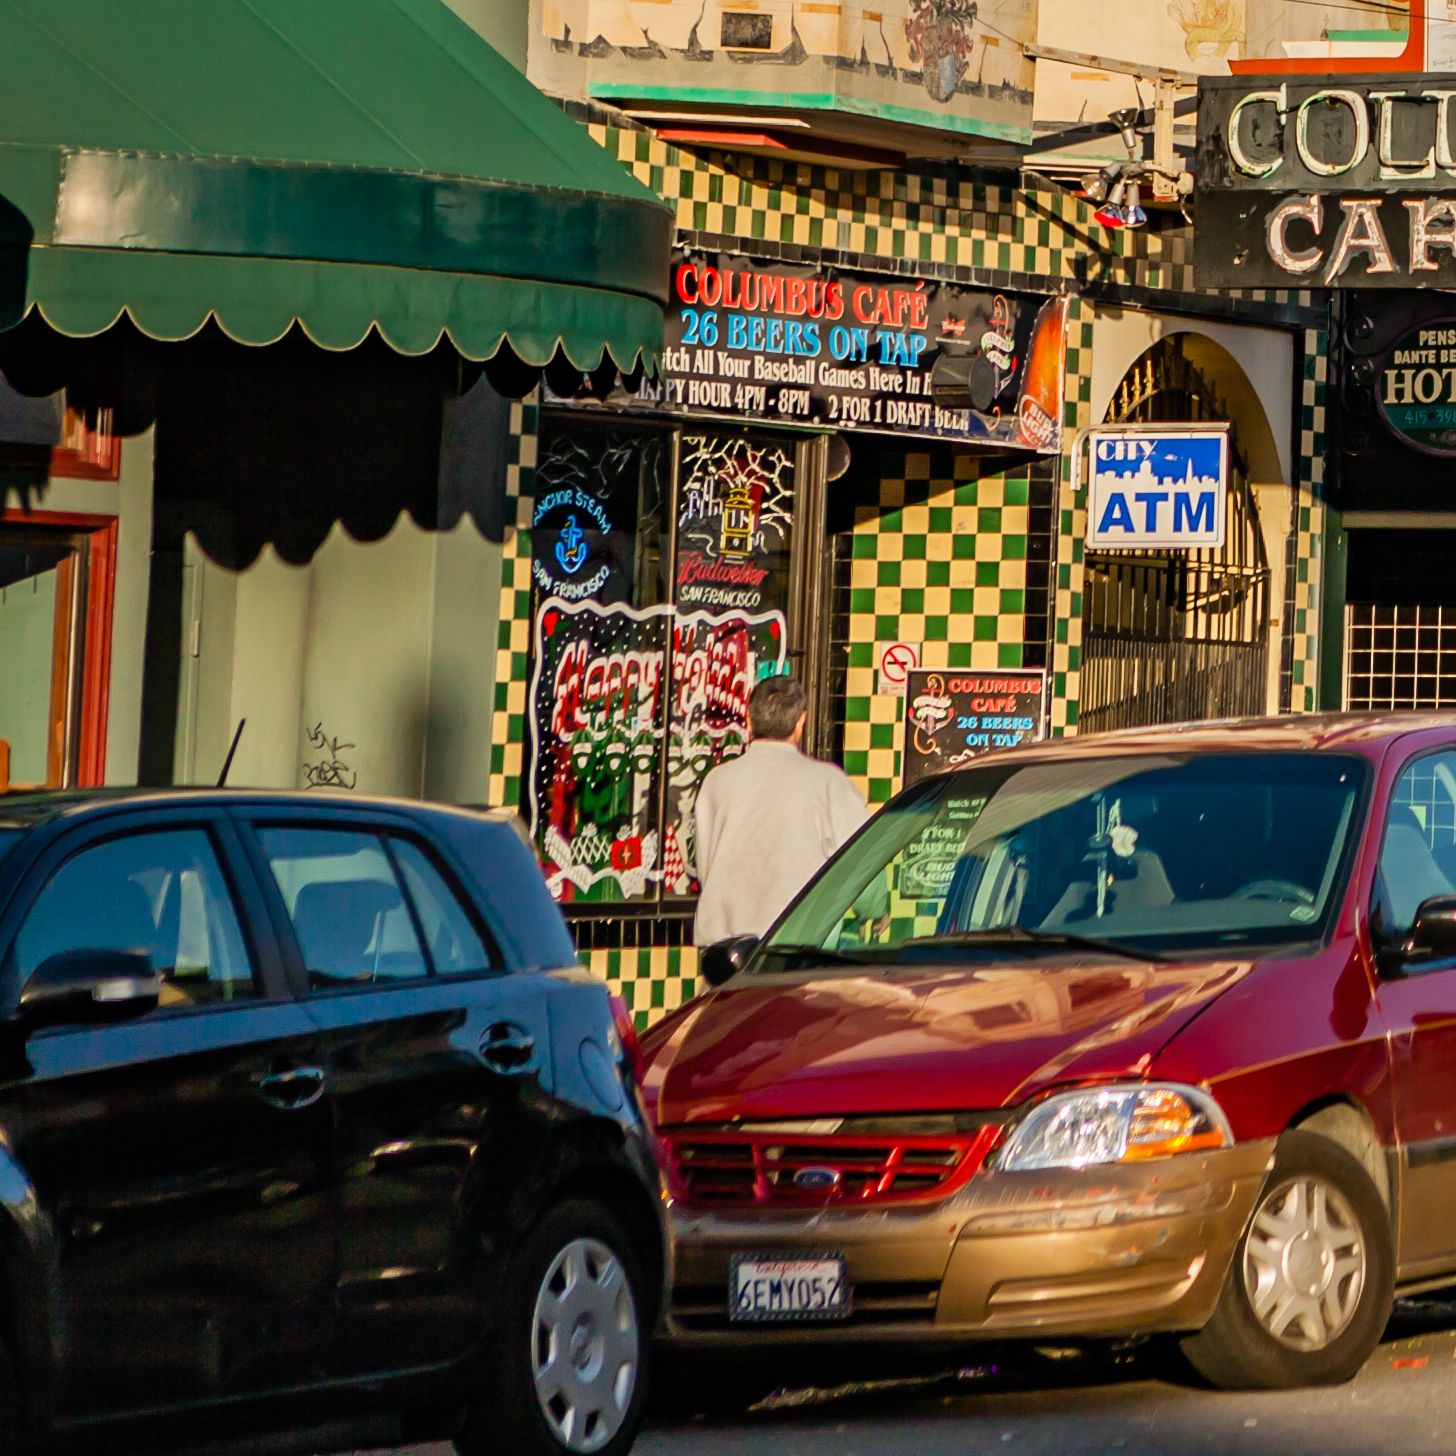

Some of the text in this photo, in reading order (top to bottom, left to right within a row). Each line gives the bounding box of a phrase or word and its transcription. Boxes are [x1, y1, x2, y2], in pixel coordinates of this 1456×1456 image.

[676, 263, 929, 330] COLUMBUS CAFÉ
[680, 308, 927, 368] 26 BEERS ON TAP
[1394, 349, 1437, 364] DANTE
[662, 347, 691, 373] tch
[693, 349, 714, 374] All
[717, 352, 751, 379] Your
[753, 355, 816, 386] Baseball
[817, 362, 866, 390] Games
[869, 366, 904, 393] Here
[906, 370, 921, 394] In
[688, 379, 732, 408] HOUR
[734, 383, 767, 412] 4PM
[778, 388, 811, 416] 8PM
[828, 395, 839, 419] 2
[841, 396, 871, 423] FOR
[873, 400, 882, 423] 1
[886, 400, 932, 427] DRAFT
[1098, 440, 1158, 461] CITY
[1097, 491, 1216, 533] ATM
[677, 550, 770, 587] Budweiser
[679, 585, 761, 608] SAN FRANCISCO
[948, 677, 1043, 695] COLUMBUS
[970, 695, 1017, 713] CAFÉ
[957, 715, 1034, 730] 26 BEERS
[965, 730, 1024, 747] ON TAP
